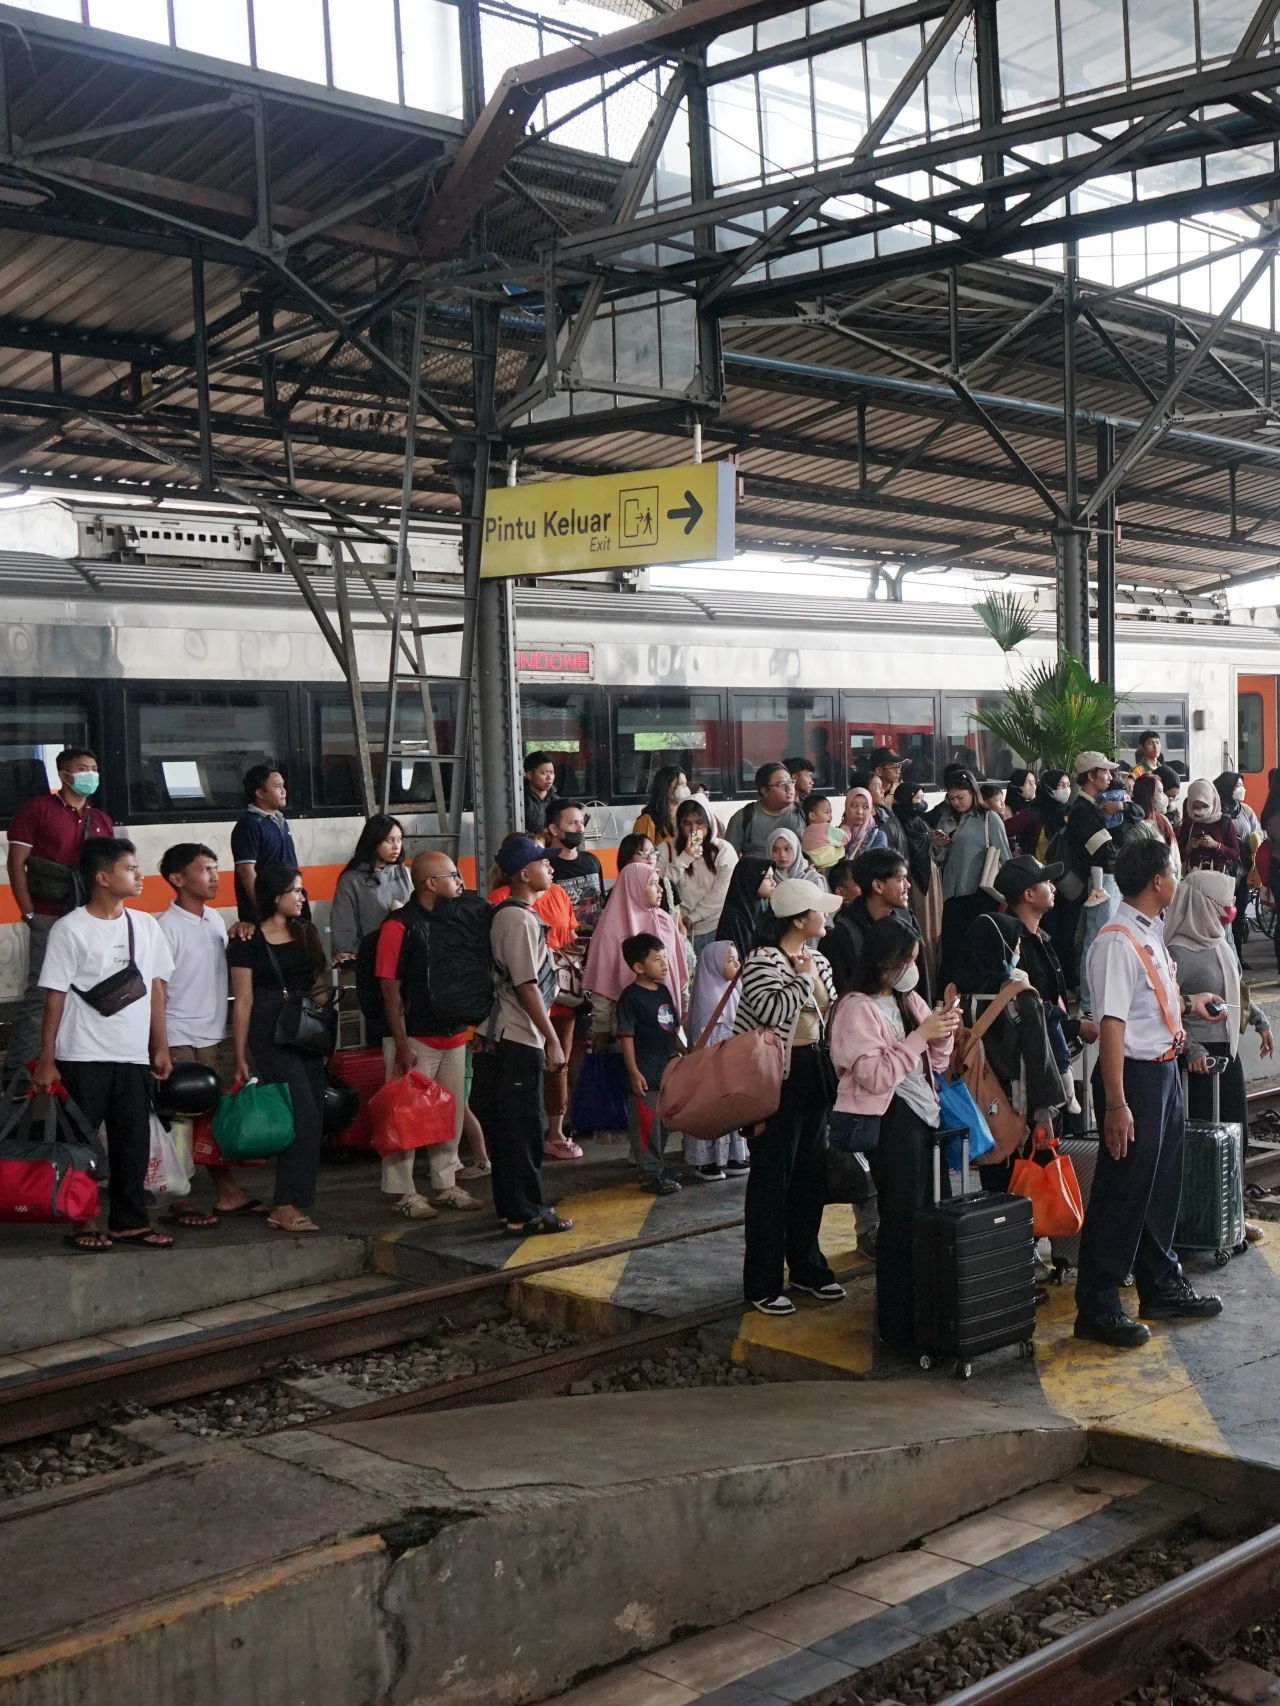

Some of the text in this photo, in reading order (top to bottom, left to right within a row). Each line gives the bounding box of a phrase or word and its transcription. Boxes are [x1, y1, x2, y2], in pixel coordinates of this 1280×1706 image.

[485, 508, 611, 543] Pintu Keluar
[589, 535, 611, 552] Exit
[516, 650, 589, 671] INDONE
